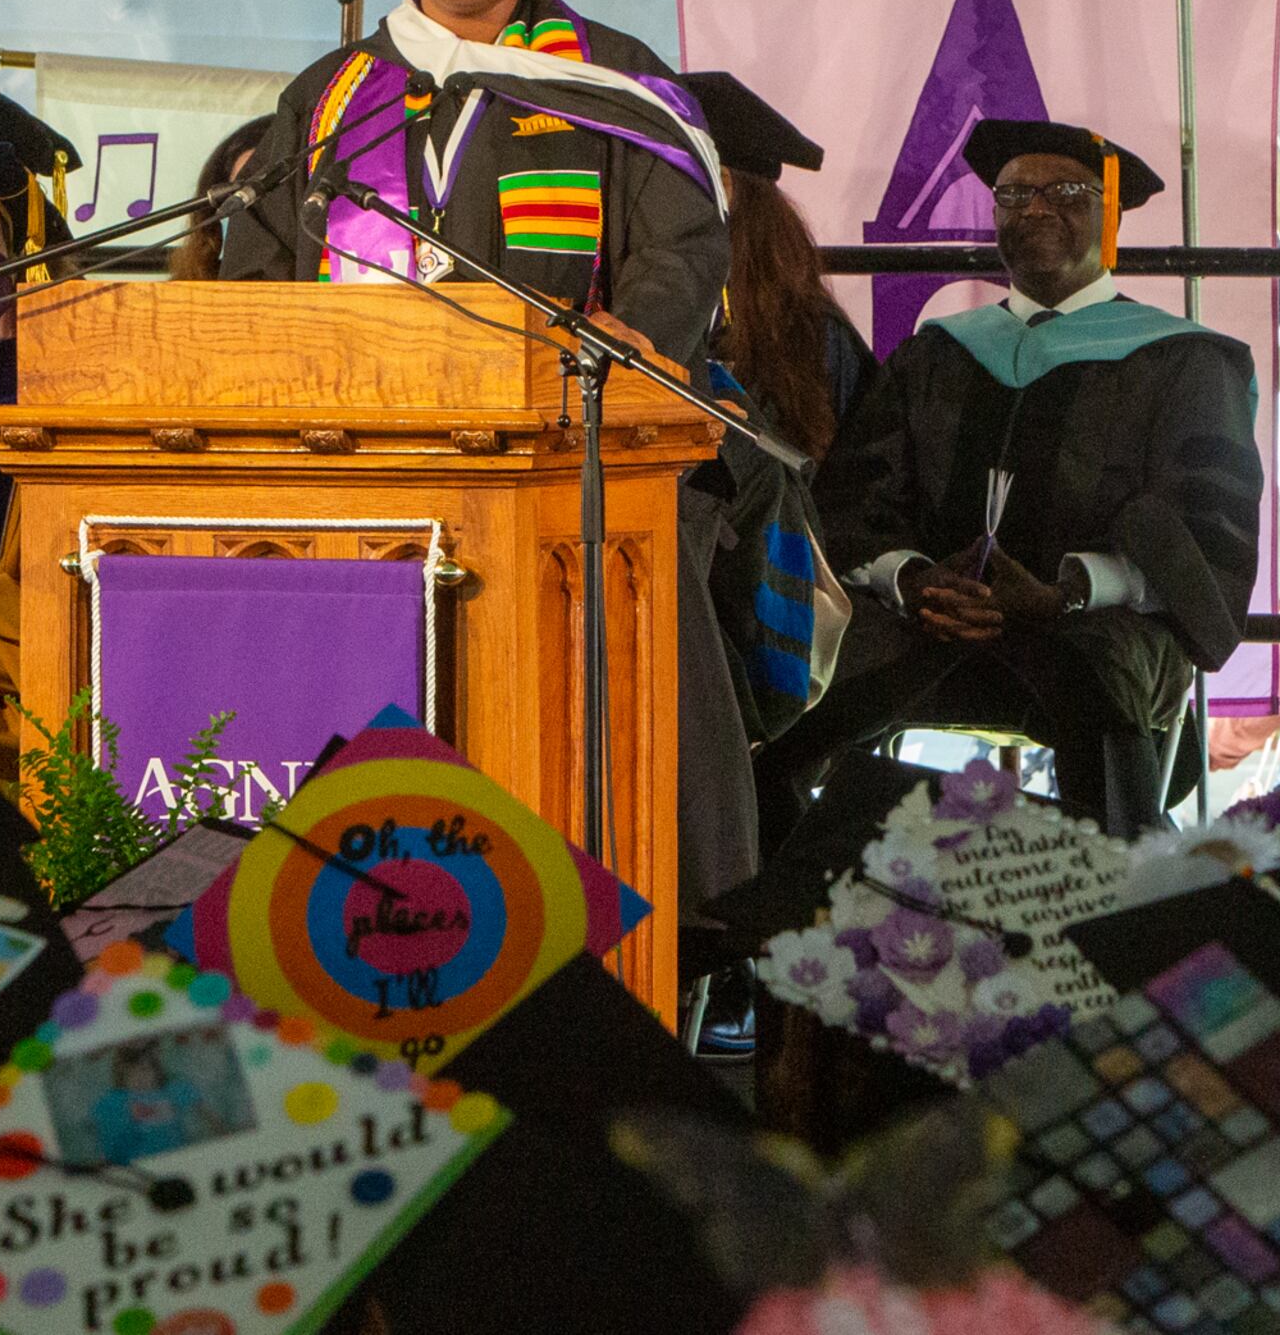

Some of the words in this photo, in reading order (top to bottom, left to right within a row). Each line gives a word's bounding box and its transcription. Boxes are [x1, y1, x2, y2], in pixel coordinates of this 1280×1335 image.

[130, 757, 315, 822] AGN
[426, 814, 494, 857] the
[941, 860, 1057, 894] outcome
[1070, 847, 1094, 870] of
[983, 874, 1088, 910] struggle
[0, 1190, 131, 1252] She
[210, 1102, 430, 1197] would
[101, 1227, 178, 1269] be
[230, 1197, 300, 1234] so
[83, 1211, 342, 1332] proud!
